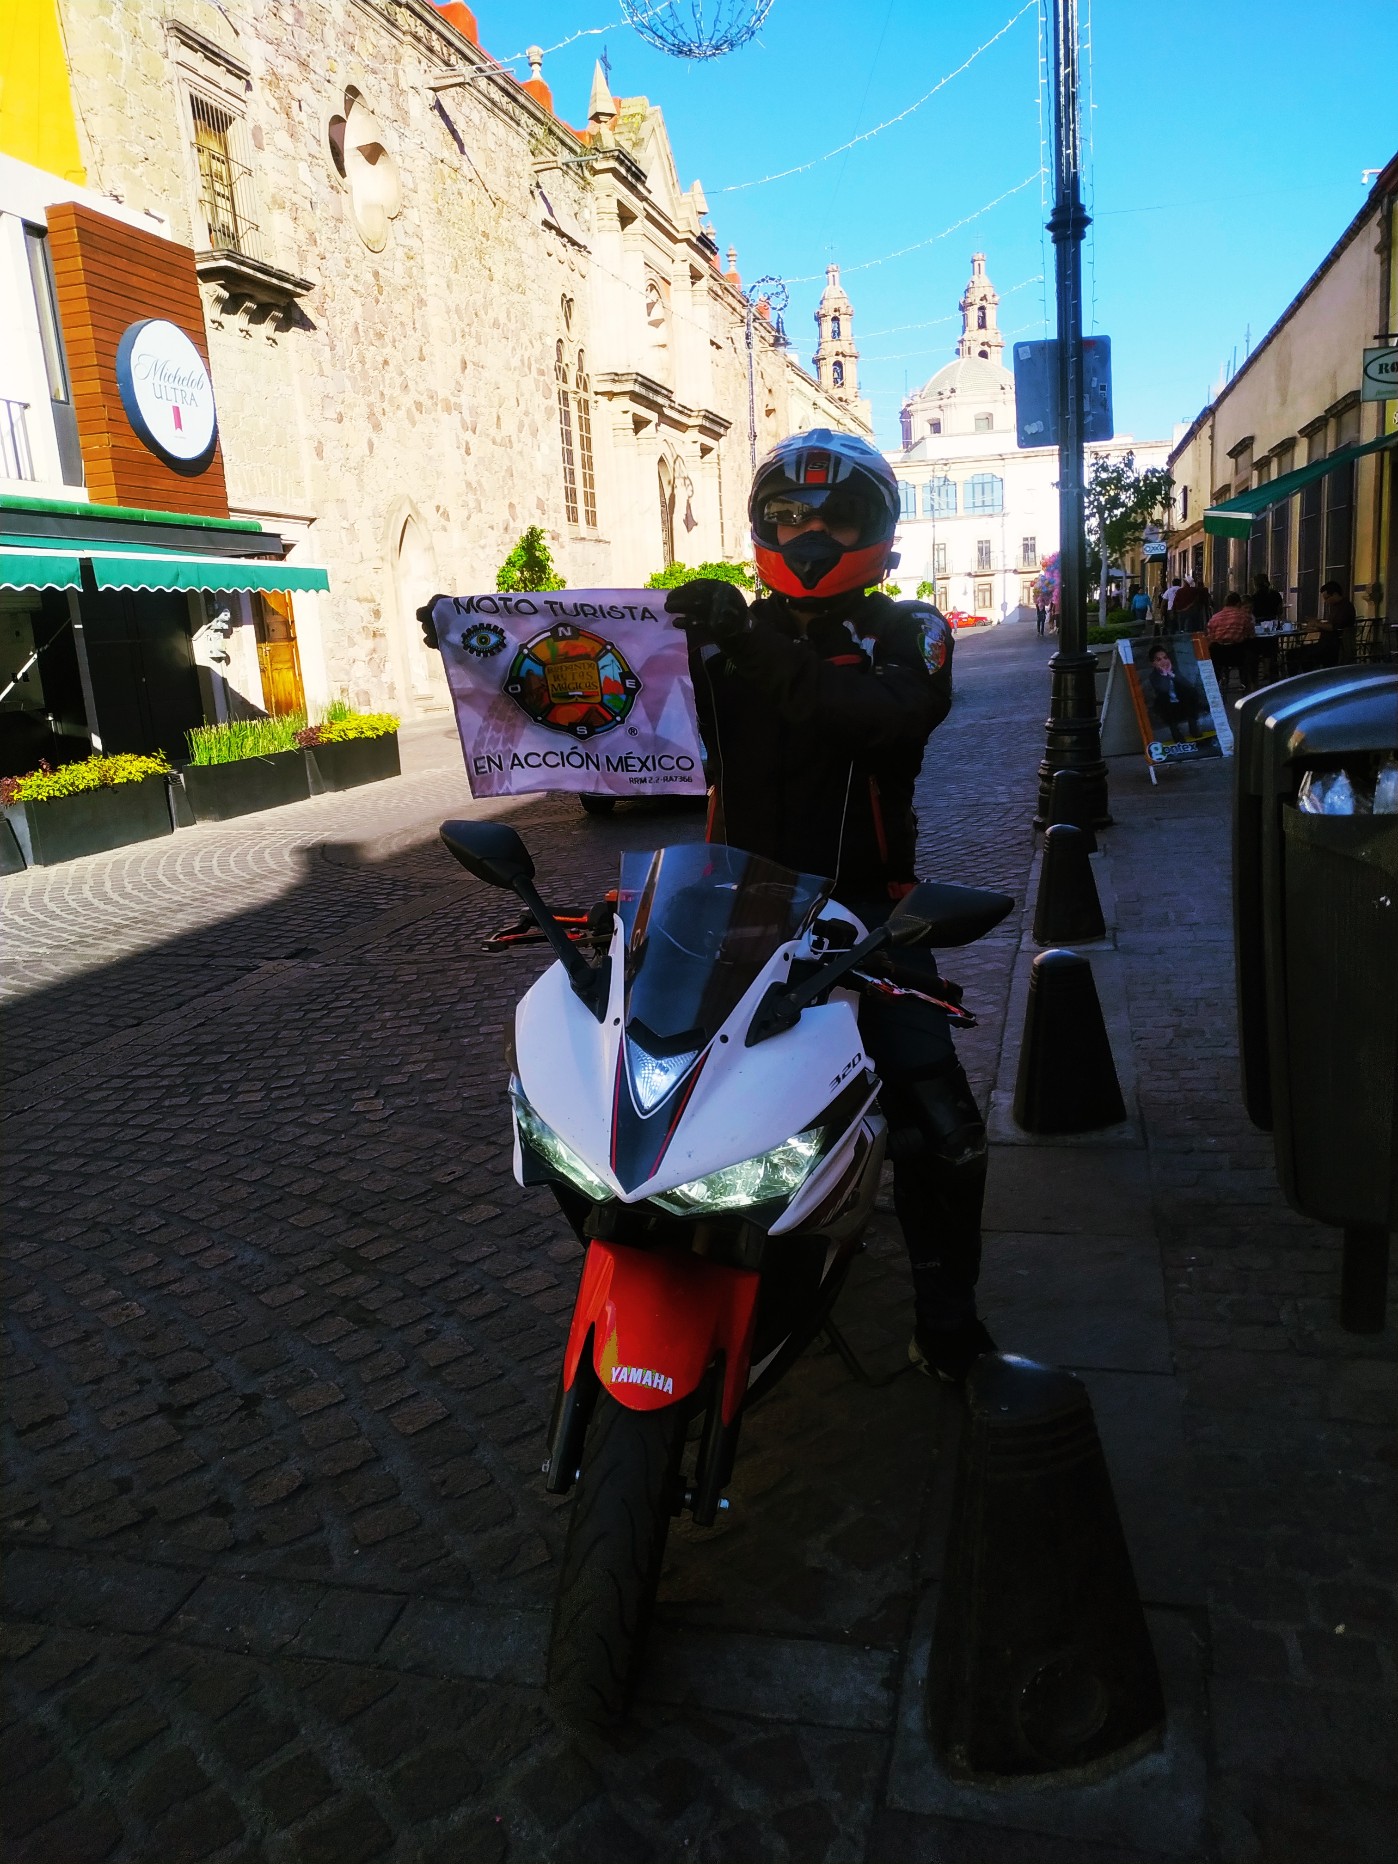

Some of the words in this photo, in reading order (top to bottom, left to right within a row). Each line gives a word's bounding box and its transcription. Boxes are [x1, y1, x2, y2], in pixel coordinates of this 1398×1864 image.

[134, 354, 205, 391] Michelob
[152, 383, 199, 407] ULTRA
[452, 596, 539, 615] MOTO
[544, 600, 659, 622] TURISTA
[557, 626, 572, 637] N
[625, 679, 637, 689] E
[576, 726, 588, 735] S
[473, 754, 504, 776] EN
[509, 746, 600, 771] ACCIÓN
[605, 751, 695, 773] MÉXICO
[828, 1052, 862, 1095] 320
[611, 1366, 674, 1394] YAMAHA
